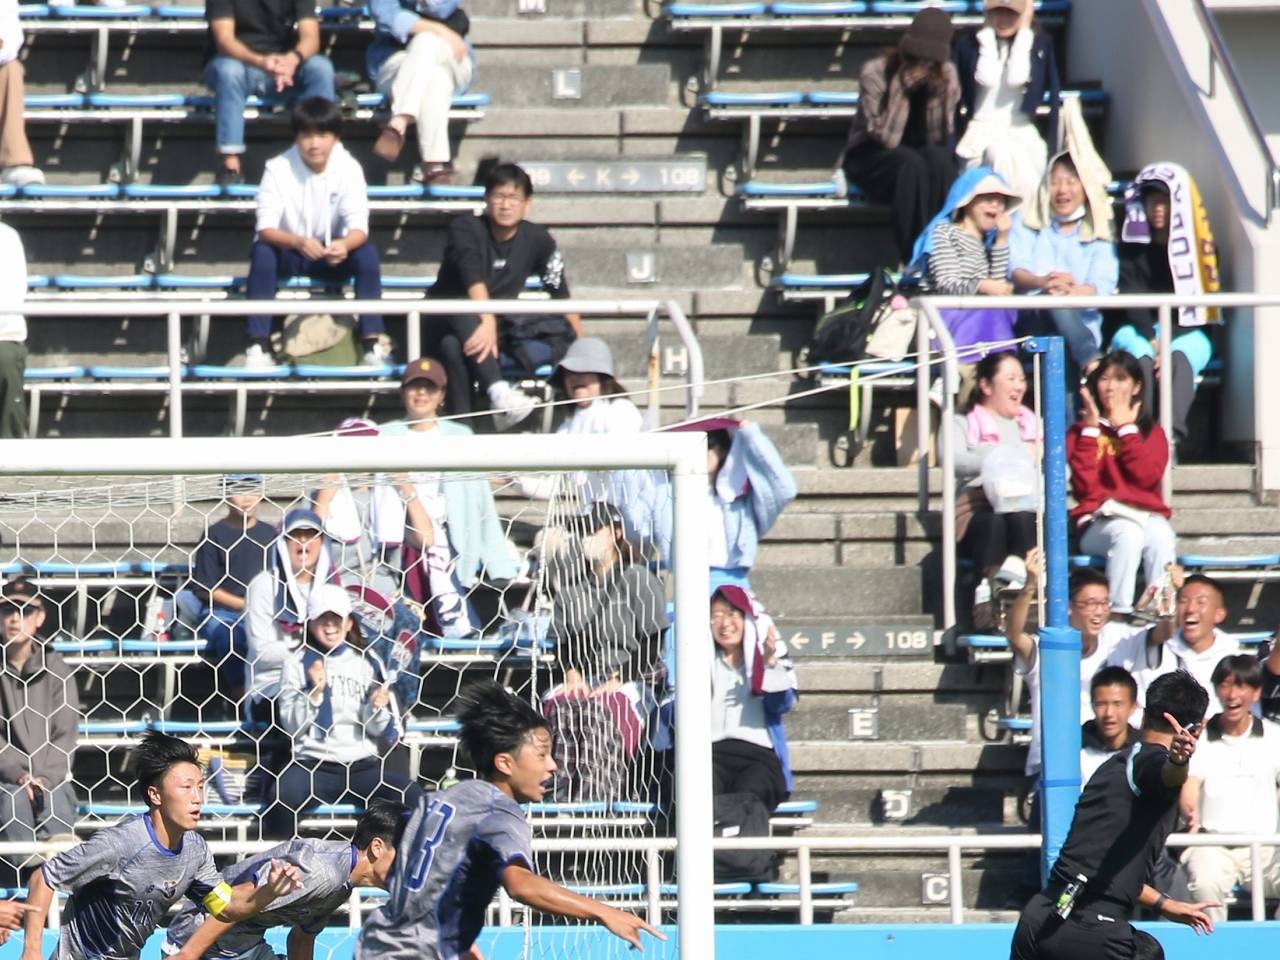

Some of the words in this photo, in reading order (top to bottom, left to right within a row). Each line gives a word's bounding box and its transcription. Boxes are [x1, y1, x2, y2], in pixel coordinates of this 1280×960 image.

[558, 72, 577, 96] L
[596, 168, 610, 186] K
[659, 167, 700, 186] 108
[631, 255, 652, 279] J
[665, 347, 688, 372] H
[821, 631, 837, 649] F
[885, 631, 928, 649] 108
[852, 713, 874, 736] E
[883, 793, 909, 819] D
[926, 877, 949, 901] C
